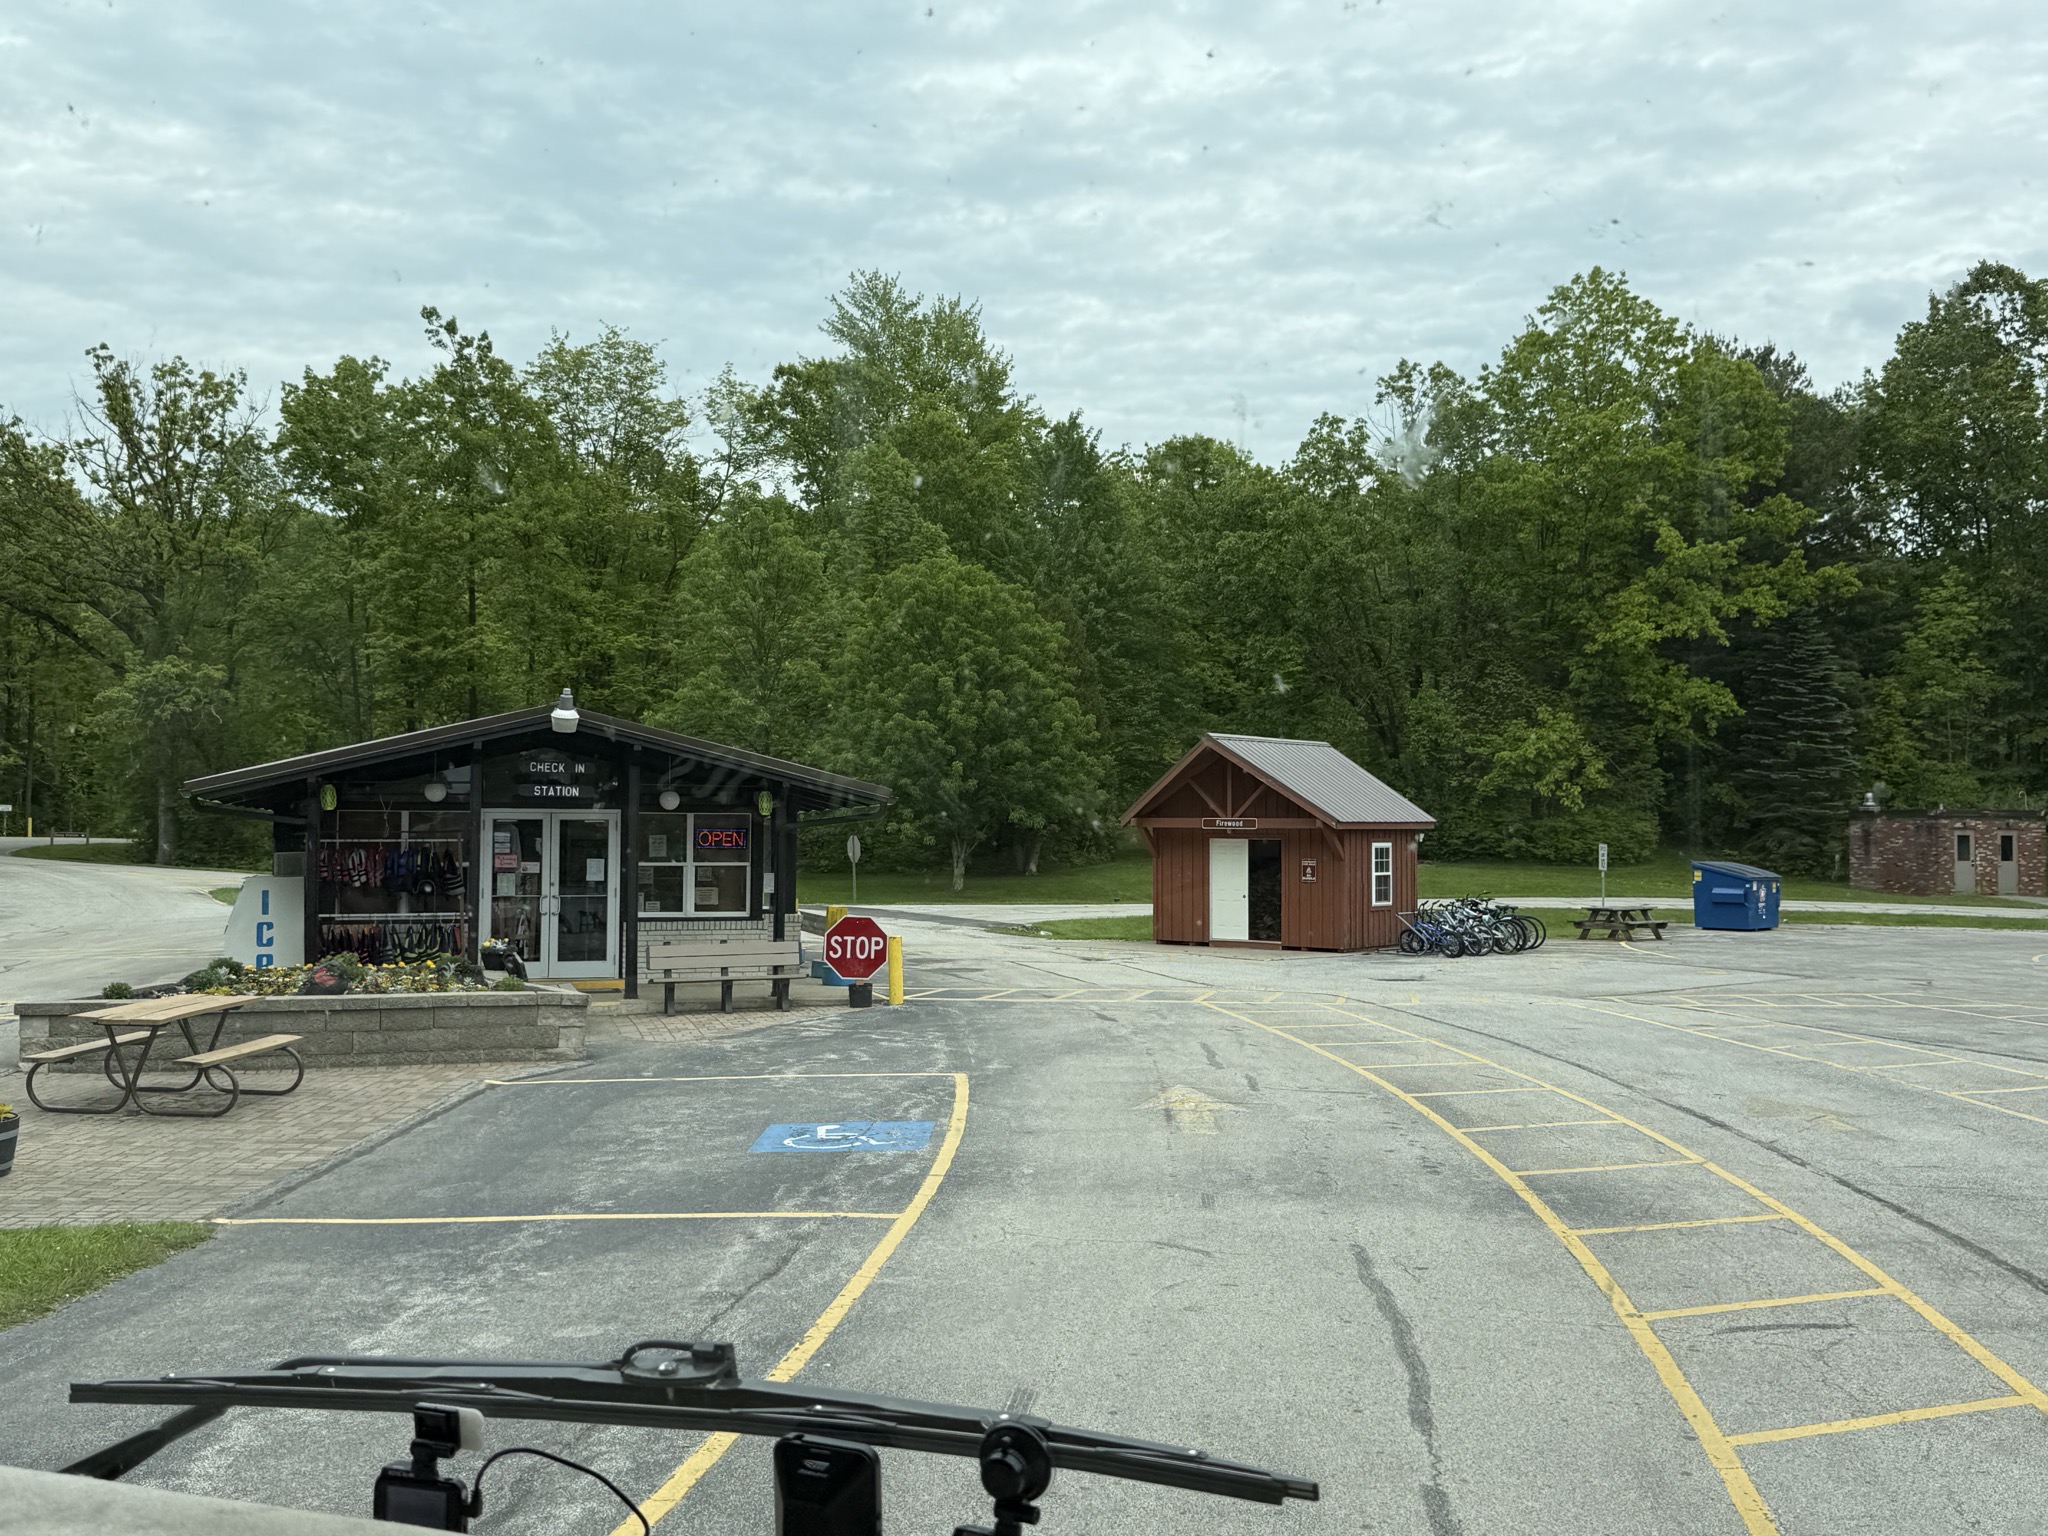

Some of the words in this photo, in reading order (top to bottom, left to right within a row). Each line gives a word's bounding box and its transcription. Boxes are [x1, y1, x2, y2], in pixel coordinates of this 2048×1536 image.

[530, 761, 565, 773] CHECK
[575, 763, 585, 774] IN
[533, 785, 580, 797] STATION
[1215, 819, 1244, 827] Firewood
[698, 830, 744, 847] OPEN
[828, 935, 884, 960] STOP
